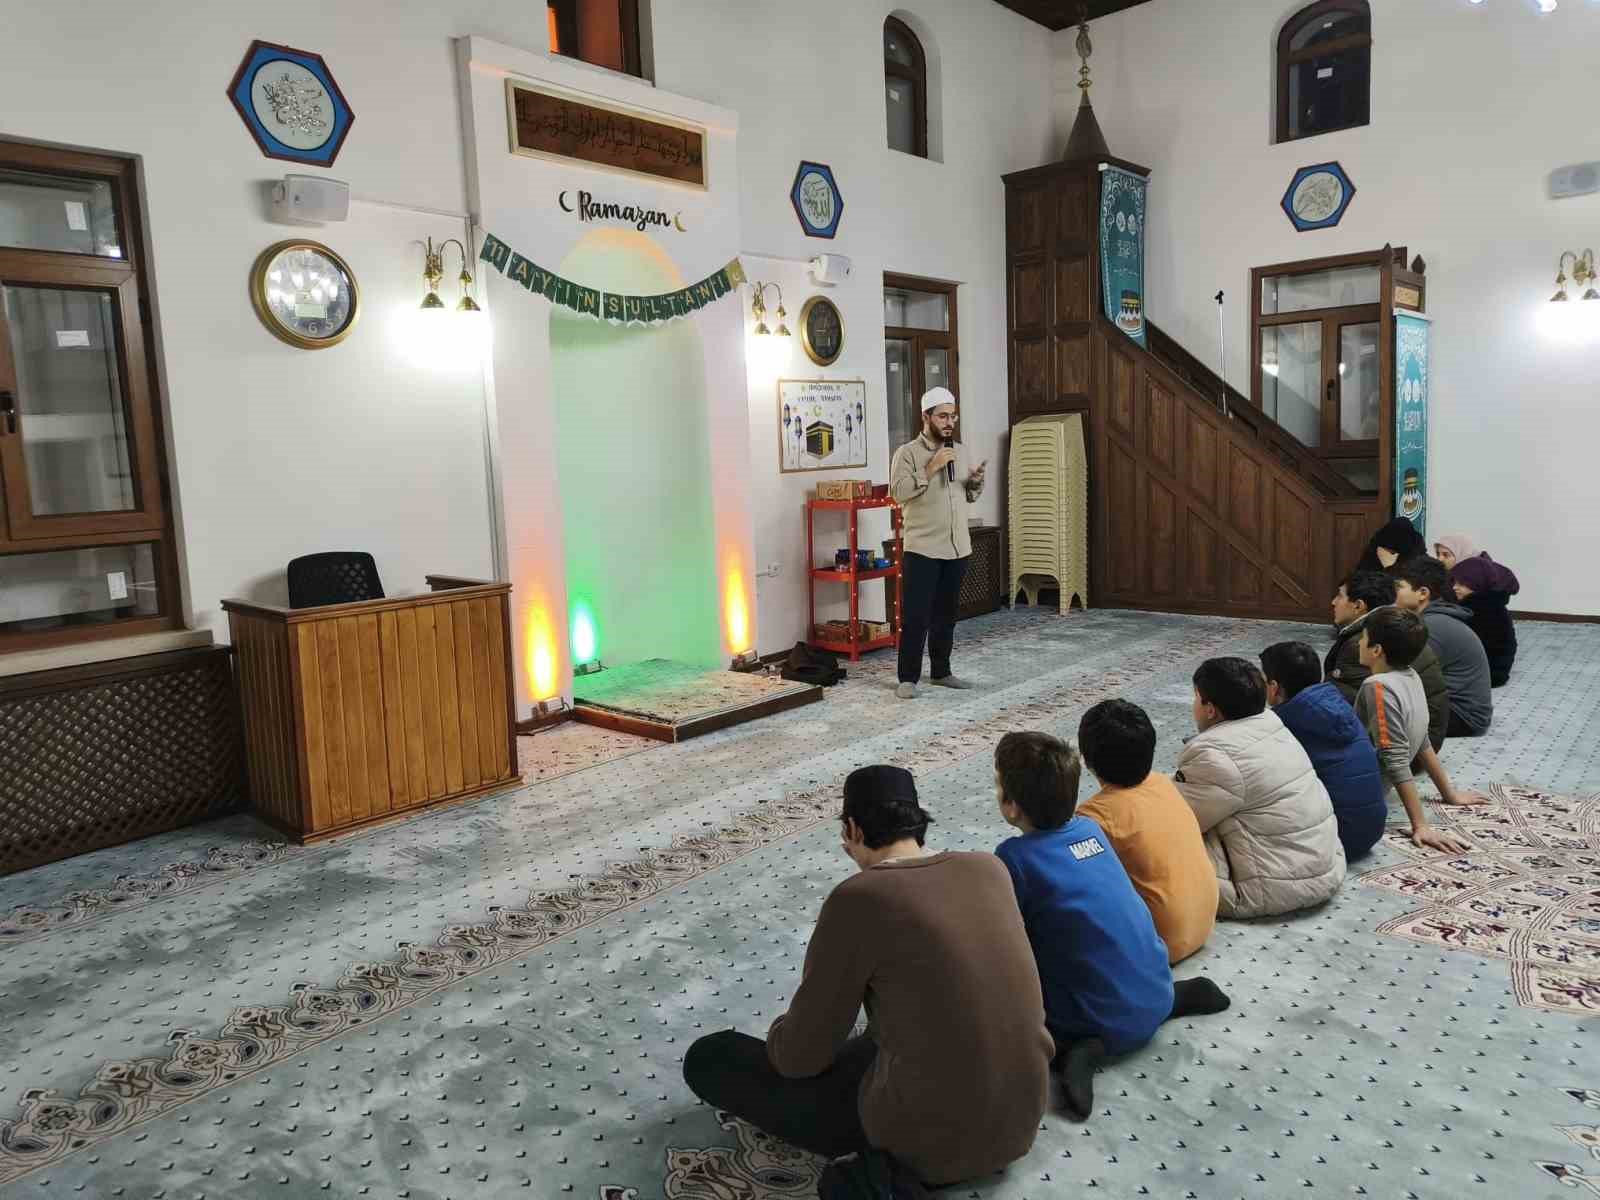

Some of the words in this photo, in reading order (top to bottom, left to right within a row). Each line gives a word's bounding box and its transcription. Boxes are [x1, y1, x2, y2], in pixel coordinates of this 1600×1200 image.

[577, 190, 671, 232] Ramazan
[490, 241, 505, 262] 11
[515, 260, 595, 309] AYIN
[608, 275, 724, 314] SULTANI
[308, 322, 317, 333] 6
